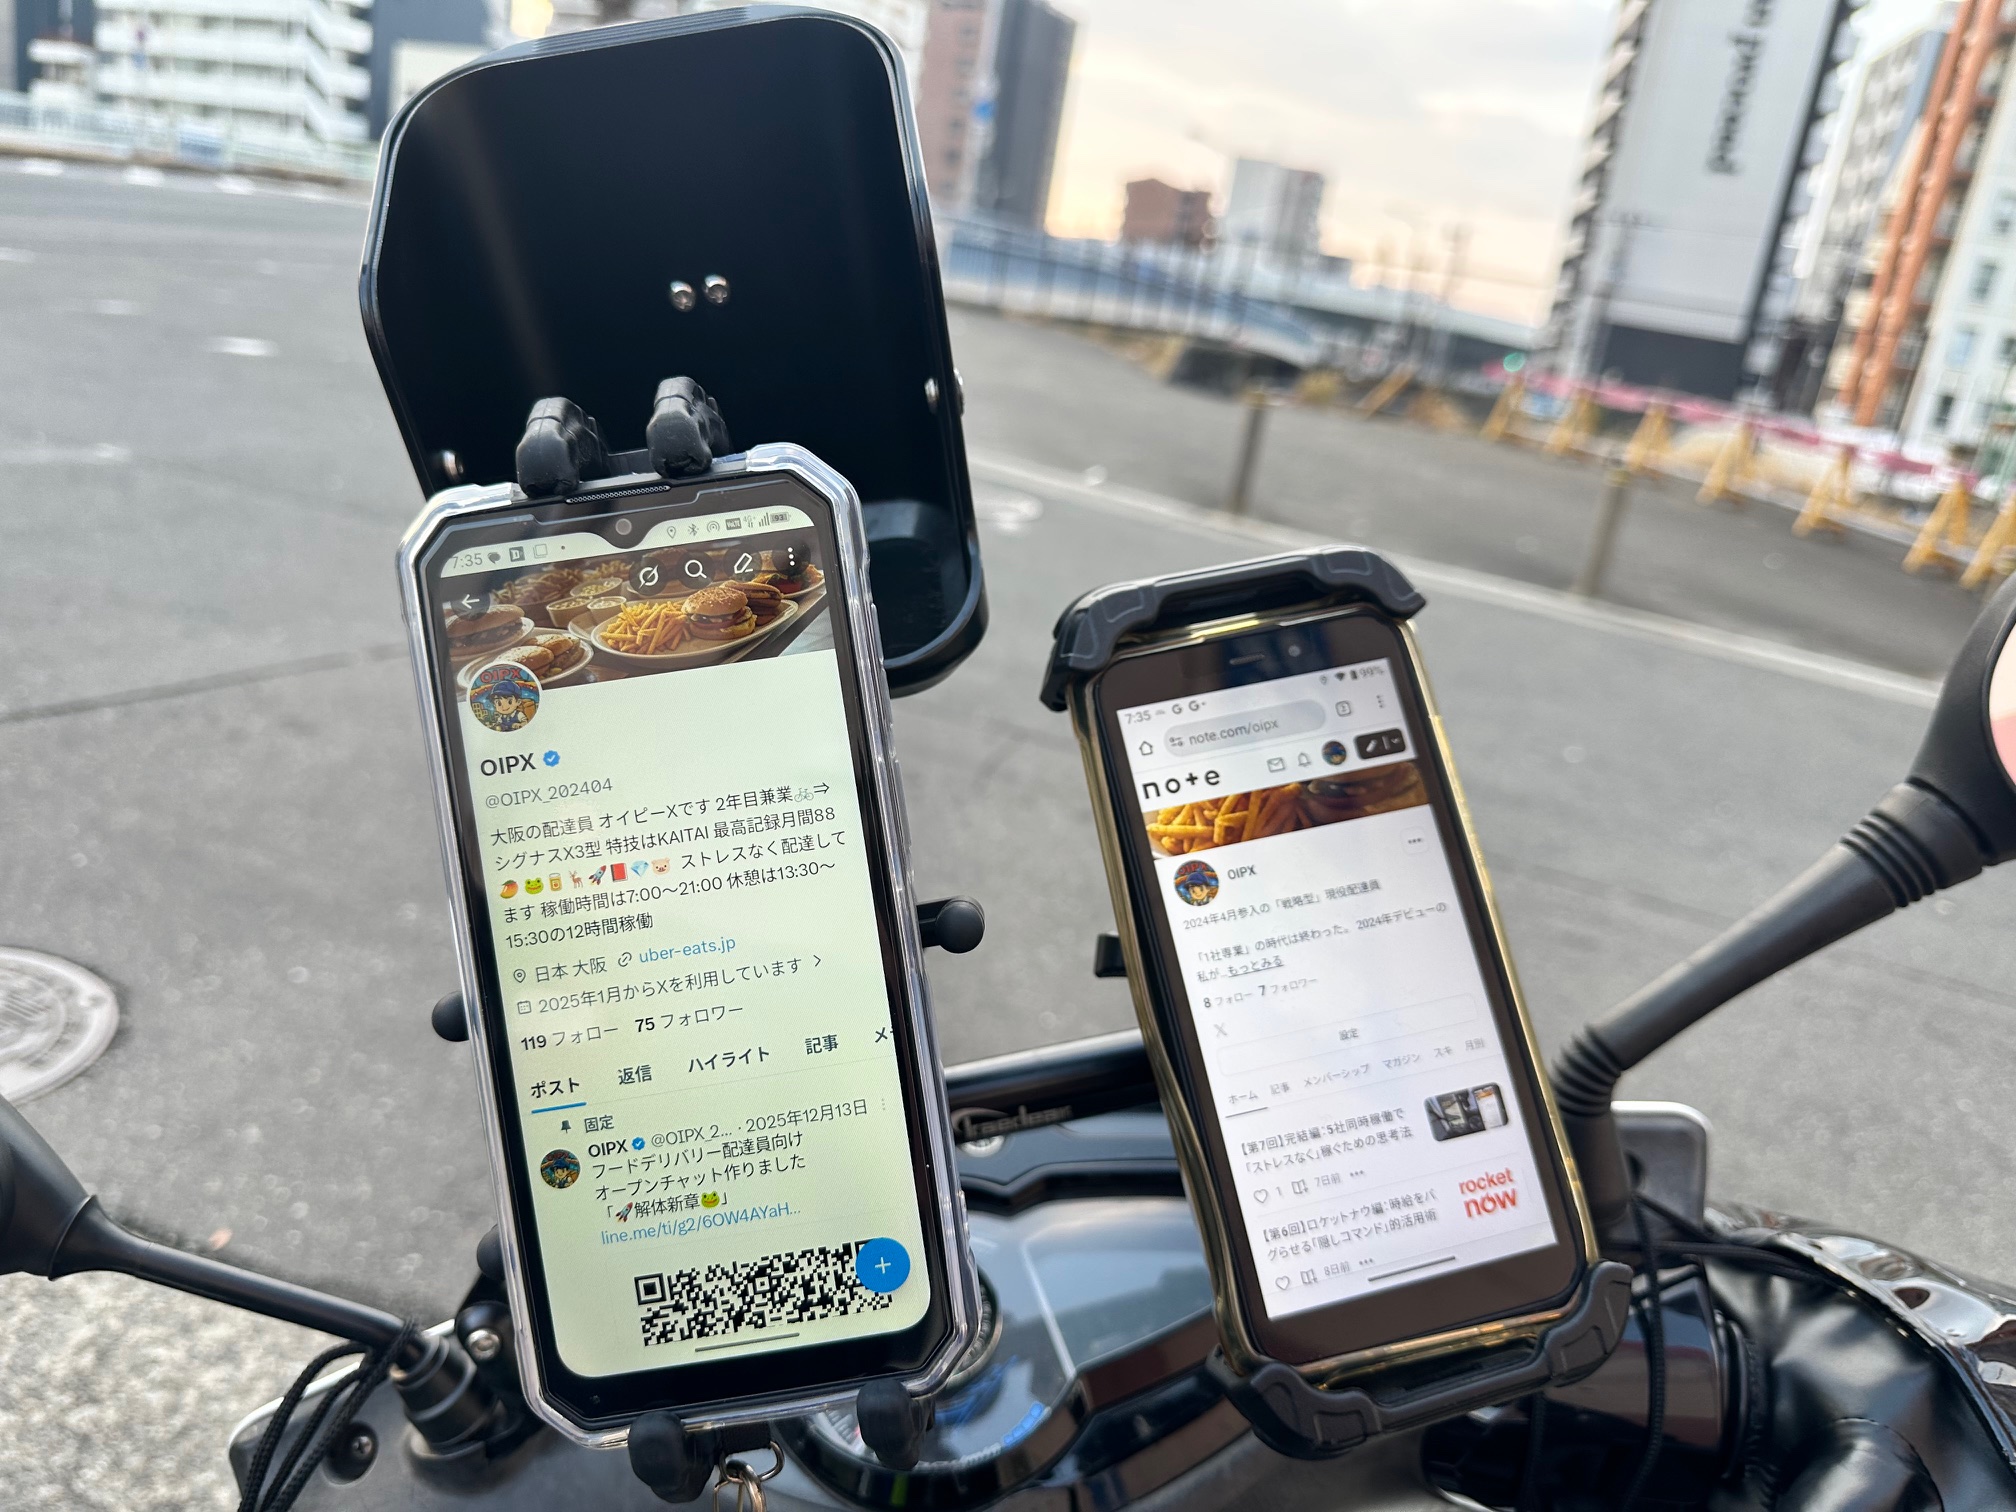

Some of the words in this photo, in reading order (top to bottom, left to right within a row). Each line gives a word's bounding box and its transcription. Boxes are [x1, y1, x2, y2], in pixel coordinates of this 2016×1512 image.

[452, 552, 483, 569] 7:35
[481, 668, 521, 683] OIPX
[1125, 710, 1152, 725] 7:35
[1188, 719, 1279, 746] note.com/oipx
[480, 753, 536, 776] OIPX
[485, 778, 613, 809] @OIPX_202404
[1142, 770, 1220, 799] note
[490, 815, 595, 846] 大阪の配達員
[599, 799, 711, 829] オイピーXです
[716, 785, 794, 811] 2年目兼業
[495, 841, 603, 871] シグナスX3型
[605, 826, 709, 855] 特技はKAITAI
[713, 807, 836, 840] 最高記録月間88
[681, 830, 846, 869] ストレスなく配達して
[1227, 865, 1257, 880] OIPX
[504, 904, 536, 923] ます
[726, 861, 836, 889] 休憩は13:30〜
[505, 911, 654, 948] 15:30の12時間稼働
[535, 962, 569, 983] 日本
[572, 956, 608, 977] 大阪
[639, 937, 736, 963] uber-eats.jp
[538, 957, 802, 1013] 2025年1月からXを利用しています
[1203, 997, 1212, 1008] 8
[1215, 992, 1253, 1007] フォロー
[1257, 985, 1266, 996] 7
[1269, 978, 1317, 994] フォロワー
[520, 1034, 548, 1051] 119
[552, 1026, 619, 1046] フォロー
[634, 1016, 656, 1032] 75
[660, 1005, 744, 1029] フォロワー
[874, 1027, 893, 1043] メ
[1339, 1028, 1359, 1040] 設定
[804, 1033, 839, 1055] 記事
[688, 1046, 770, 1072] ハイライト
[530, 1077, 580, 1098] ポスト
[617, 1064, 653, 1085] 返信
[1228, 1090, 1259, 1104] ホーム
[1303, 1063, 1370, 1087] メンバーシップ
[1382, 1053, 1421, 1069] マガジン
[584, 1114, 615, 1133] 固定
[588, 1139, 629, 1158] OIPX
[745, 1098, 868, 1133] 2025年12月13日
[592, 1131, 804, 1179] フードデリバリー配達員向け
[595, 1153, 807, 1201] オープンチャット作りました
[1458, 1167, 1515, 1195] rocket
[1463, 1188, 1519, 1218] now
